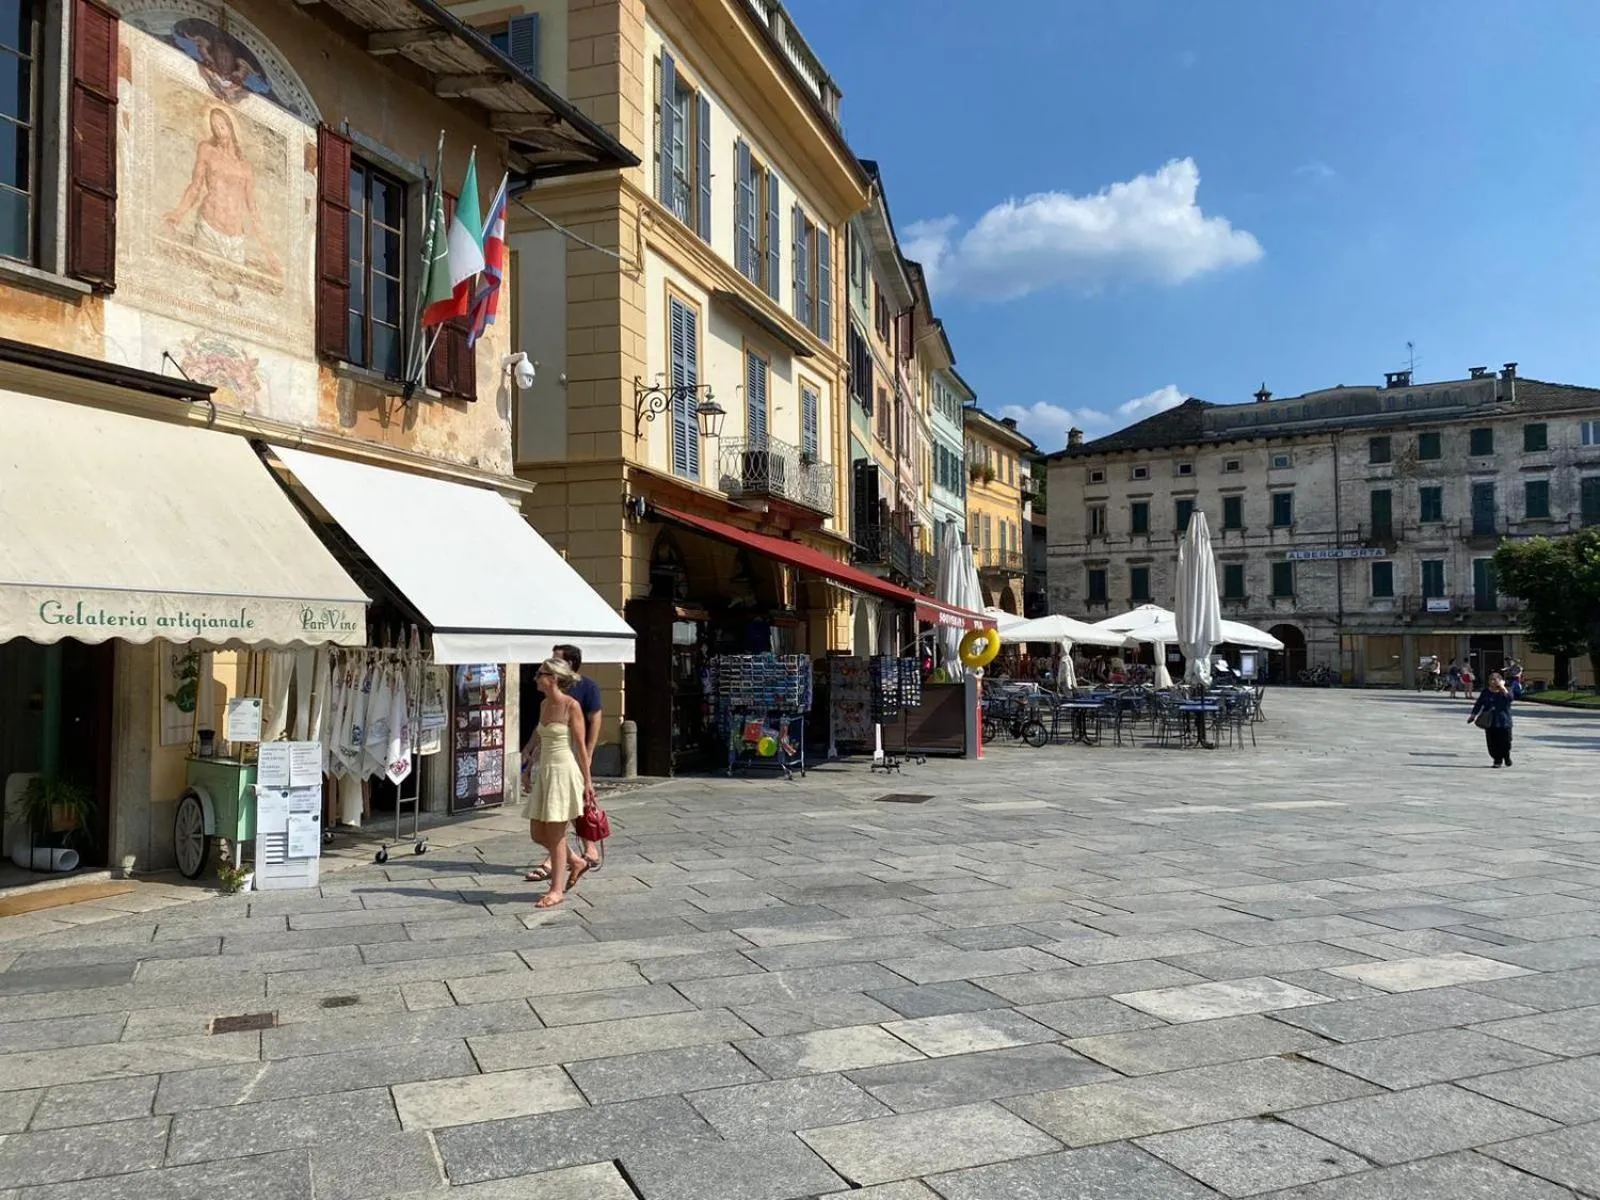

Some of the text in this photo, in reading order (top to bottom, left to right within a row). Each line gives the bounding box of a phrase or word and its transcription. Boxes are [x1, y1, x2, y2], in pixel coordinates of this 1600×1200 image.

[1289, 549, 1384, 559] ALBERGO ORTA
[39, 599, 255, 635] Gelateria artigianale
